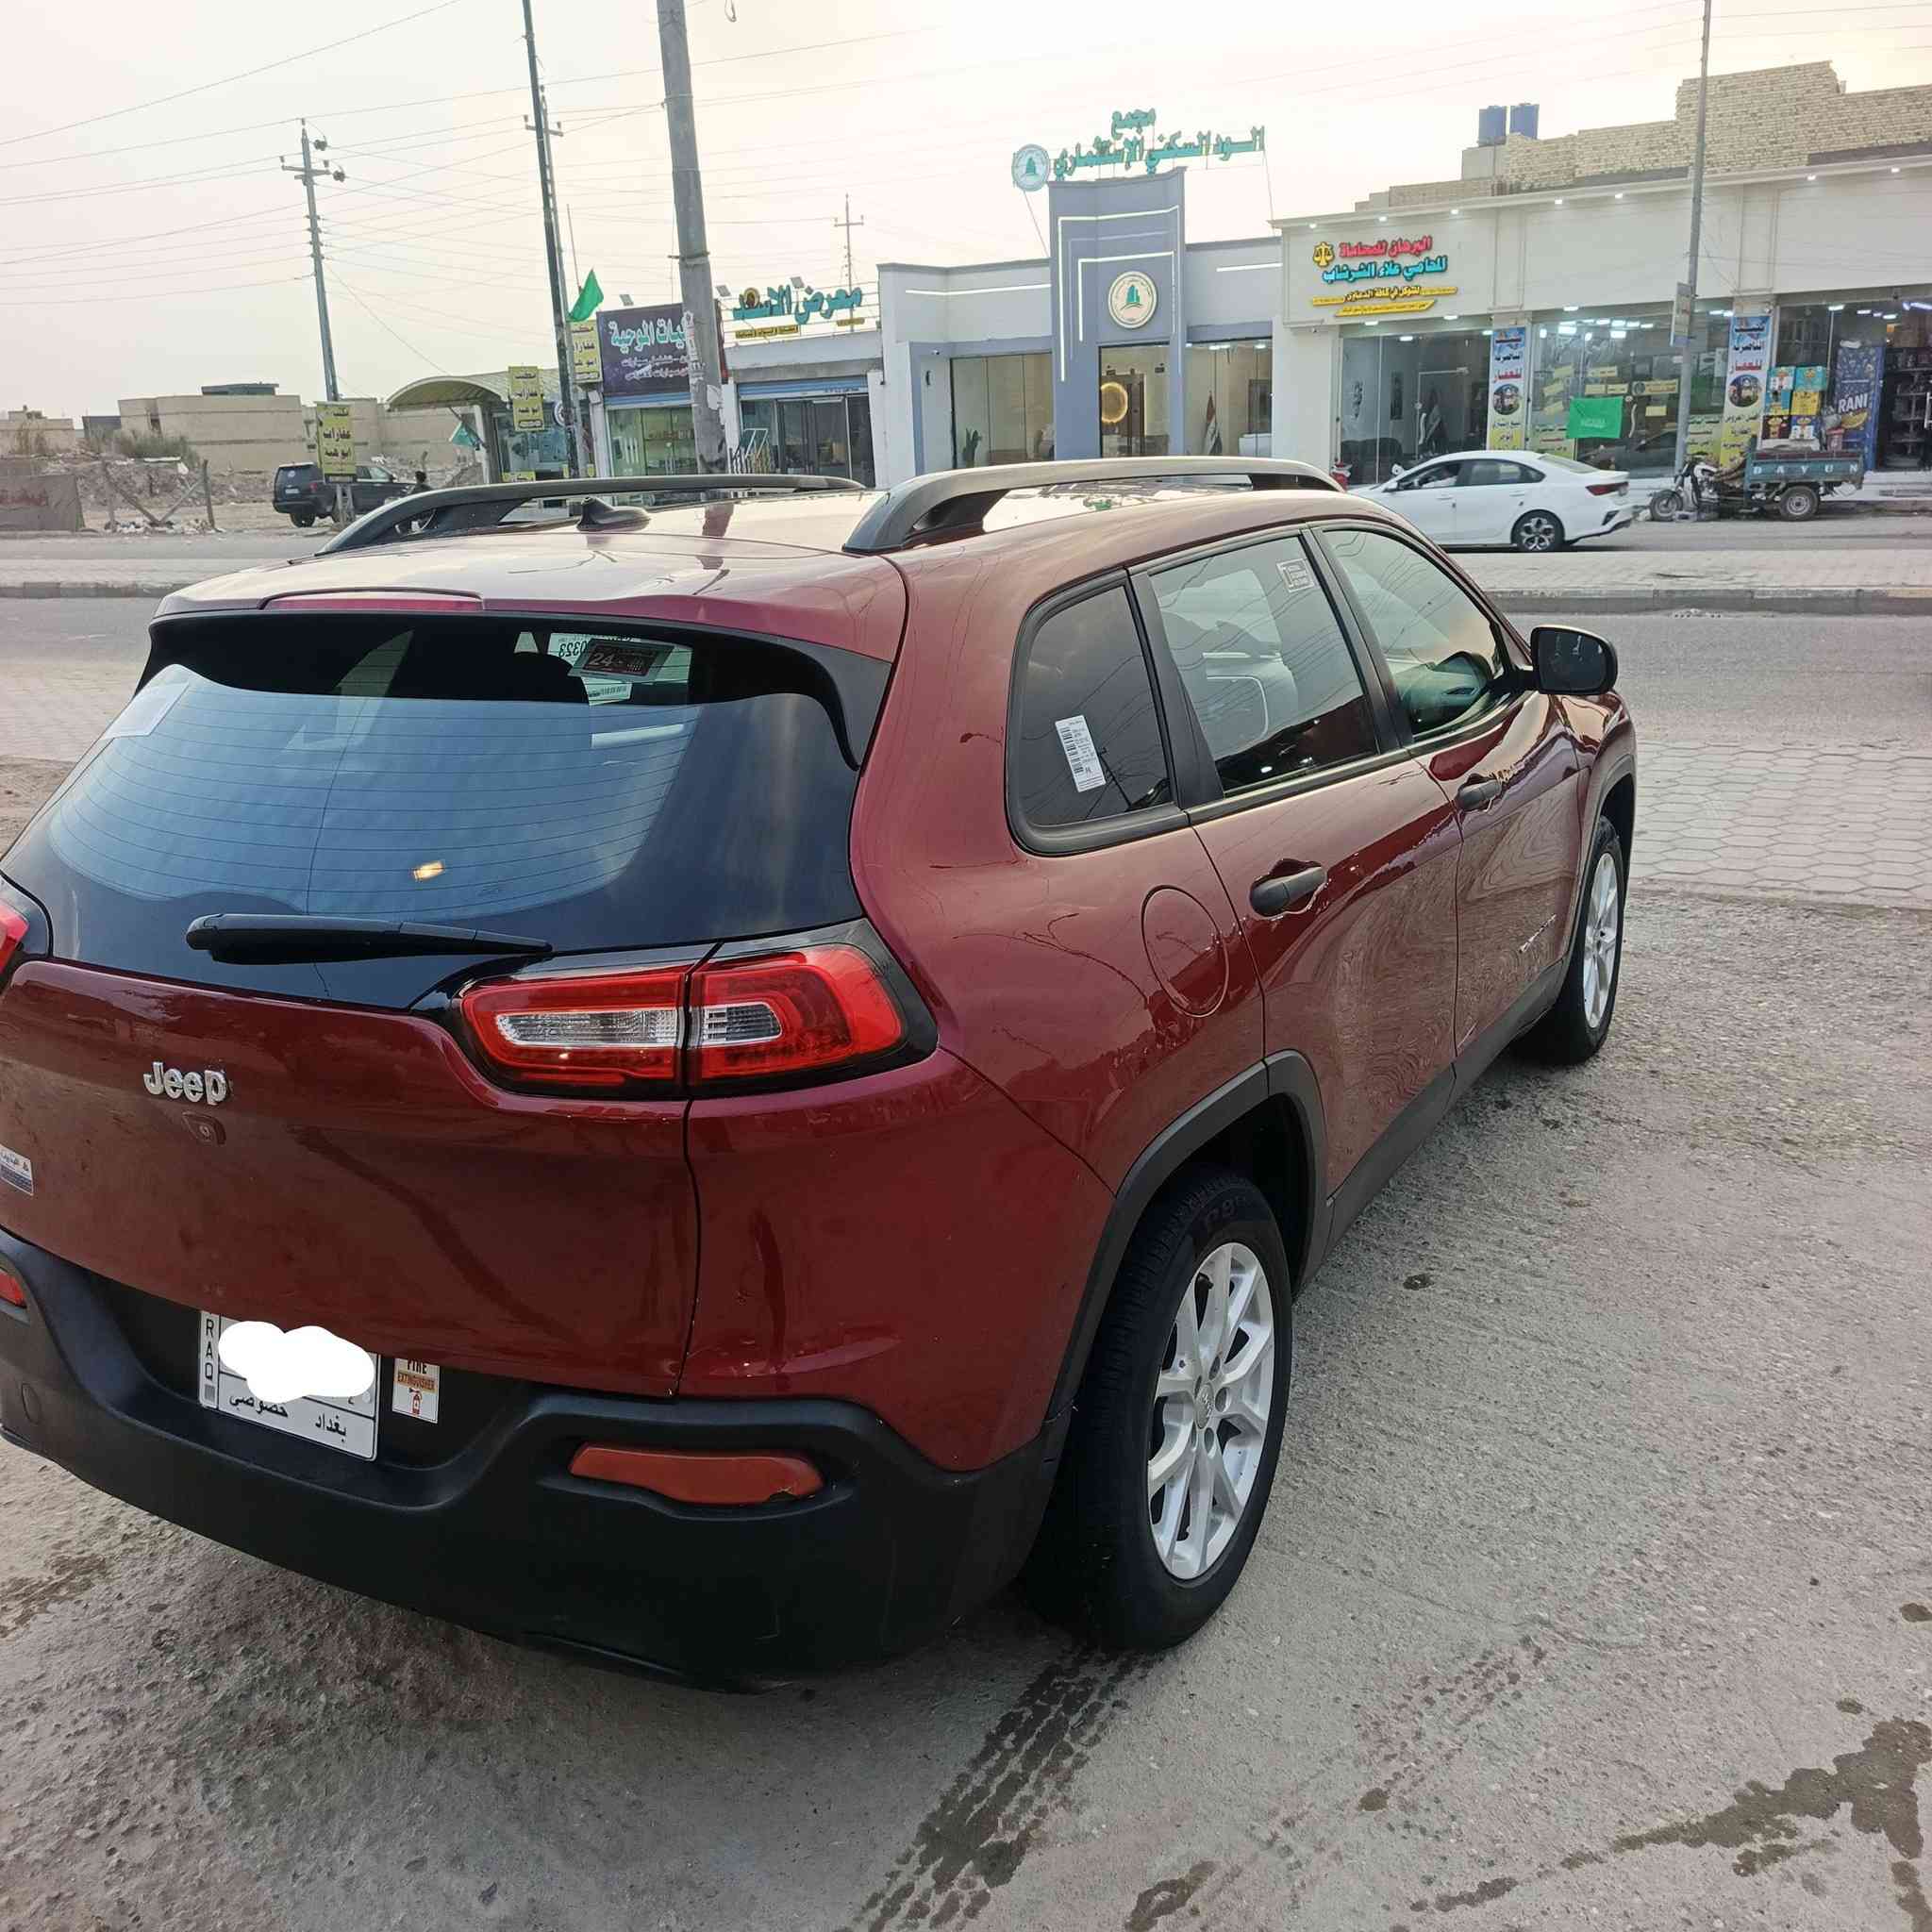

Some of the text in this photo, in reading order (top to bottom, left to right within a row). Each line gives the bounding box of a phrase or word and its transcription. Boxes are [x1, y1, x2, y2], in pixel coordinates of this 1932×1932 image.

[1403, 255, 1449, 282] المحامي
[1839, 393, 1868, 413] RANI
[1753, 462, 1858, 475] DAYUN
[143, 1061, 227, 1105] Jeep
[314, 1412, 347, 1442] بغداد
